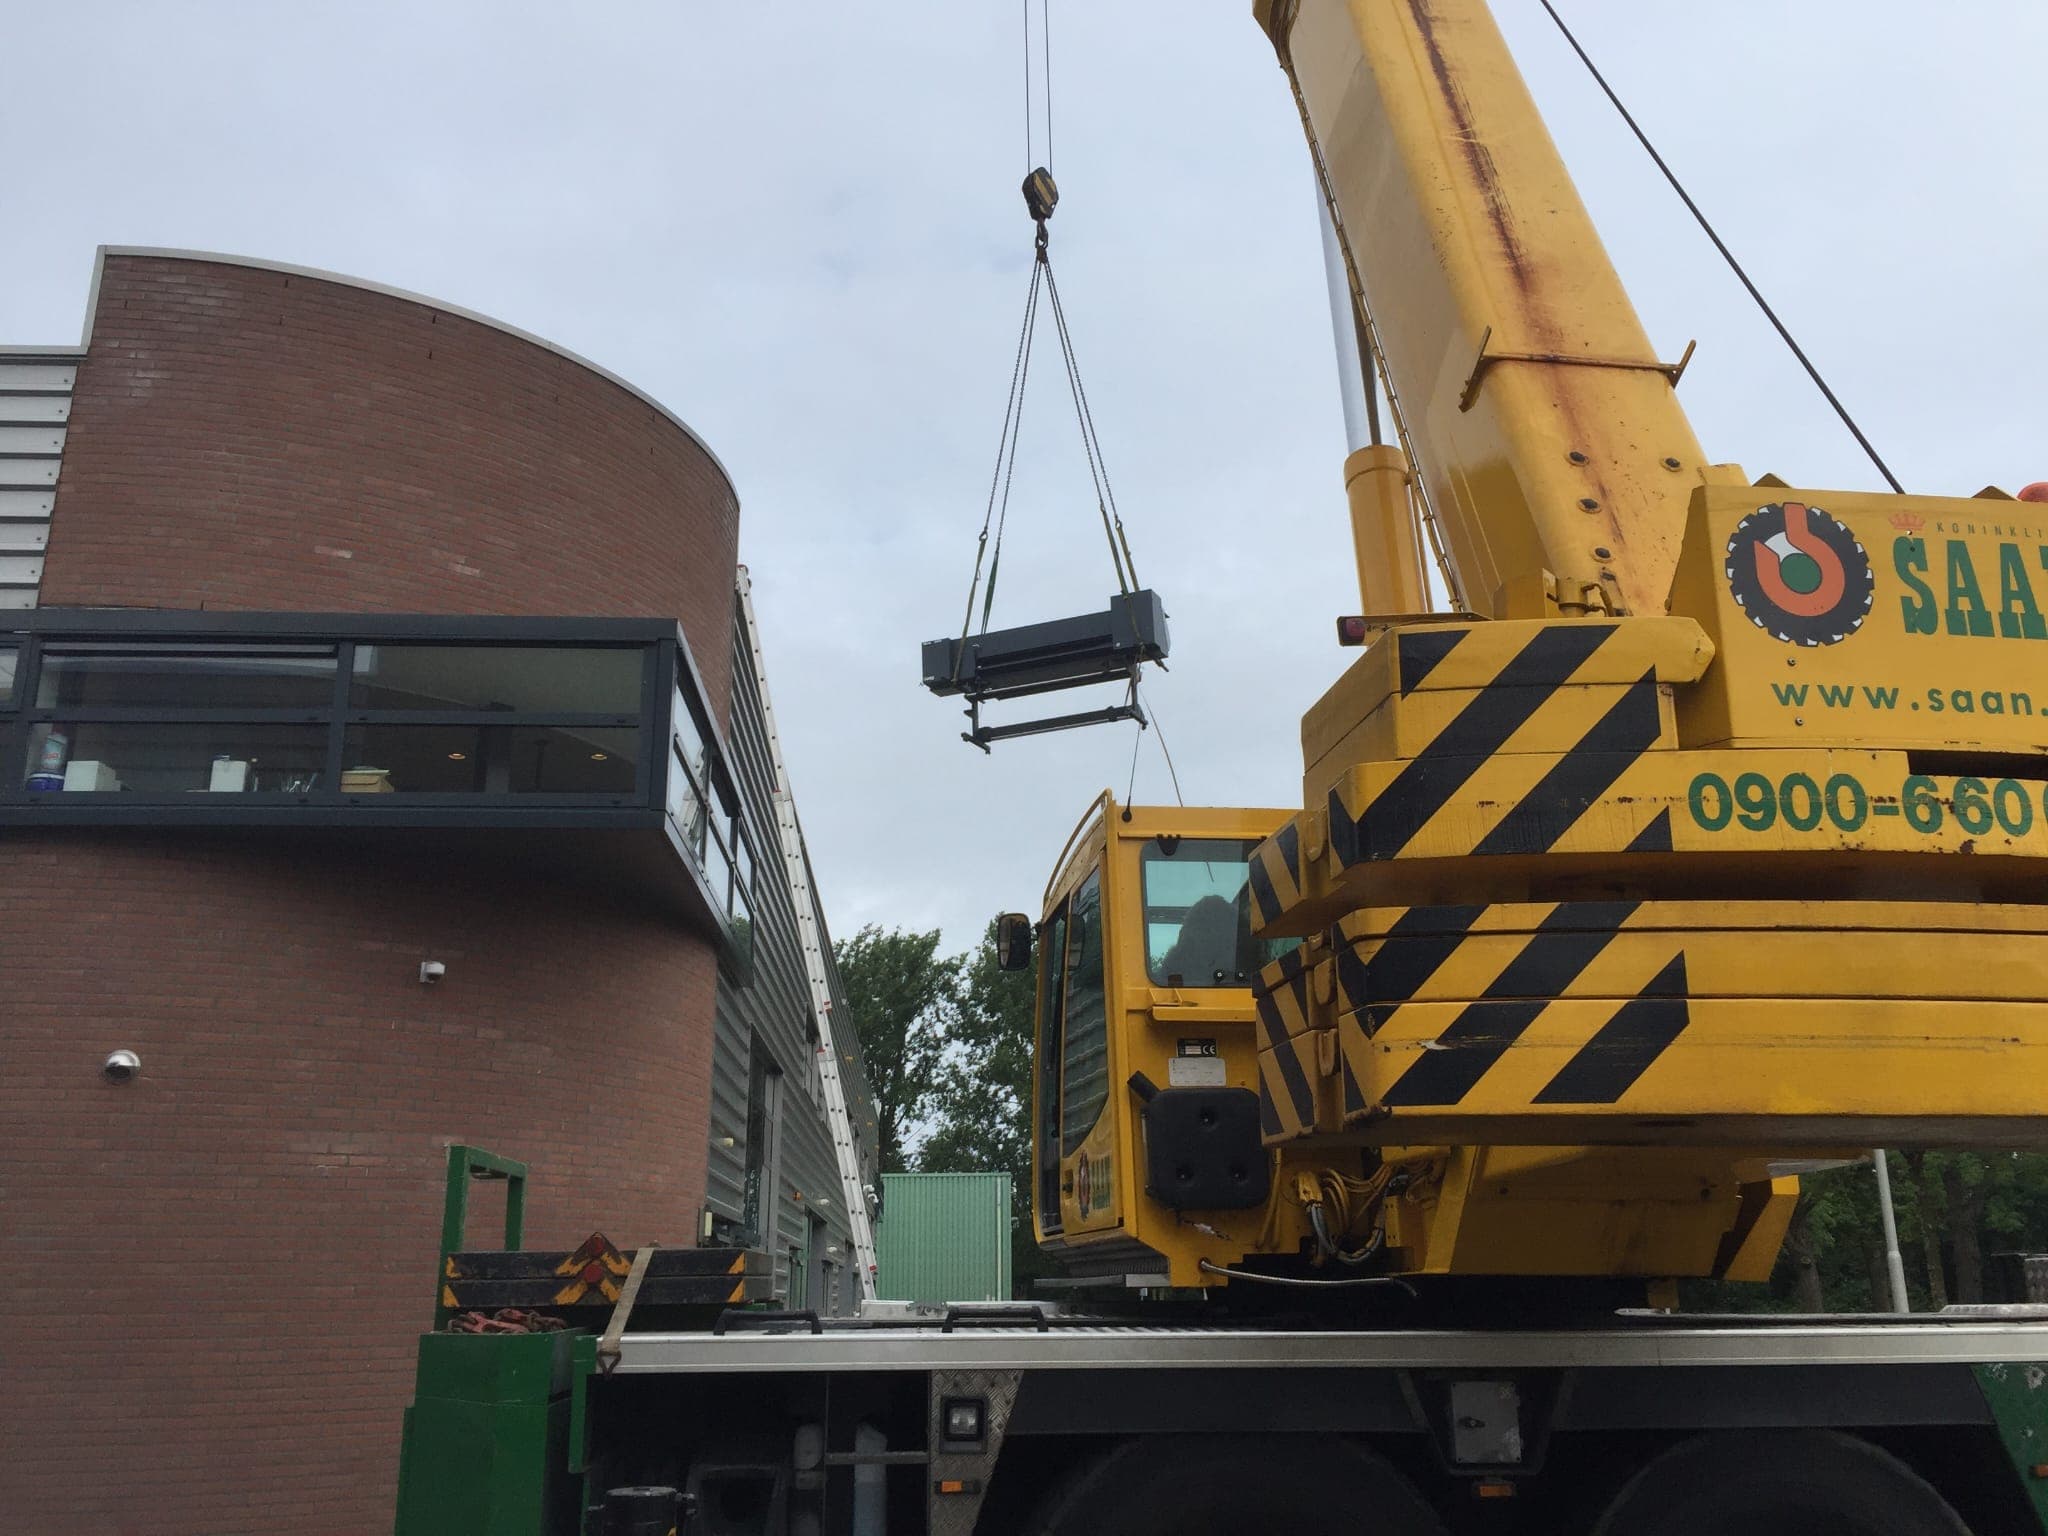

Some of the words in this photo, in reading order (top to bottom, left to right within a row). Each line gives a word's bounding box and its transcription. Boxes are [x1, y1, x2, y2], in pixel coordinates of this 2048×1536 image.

[1893, 536, 2048, 640] SAA
[1688, 772, 2048, 837] 0900-660
[1202, 1045, 1216, 1055] CE
